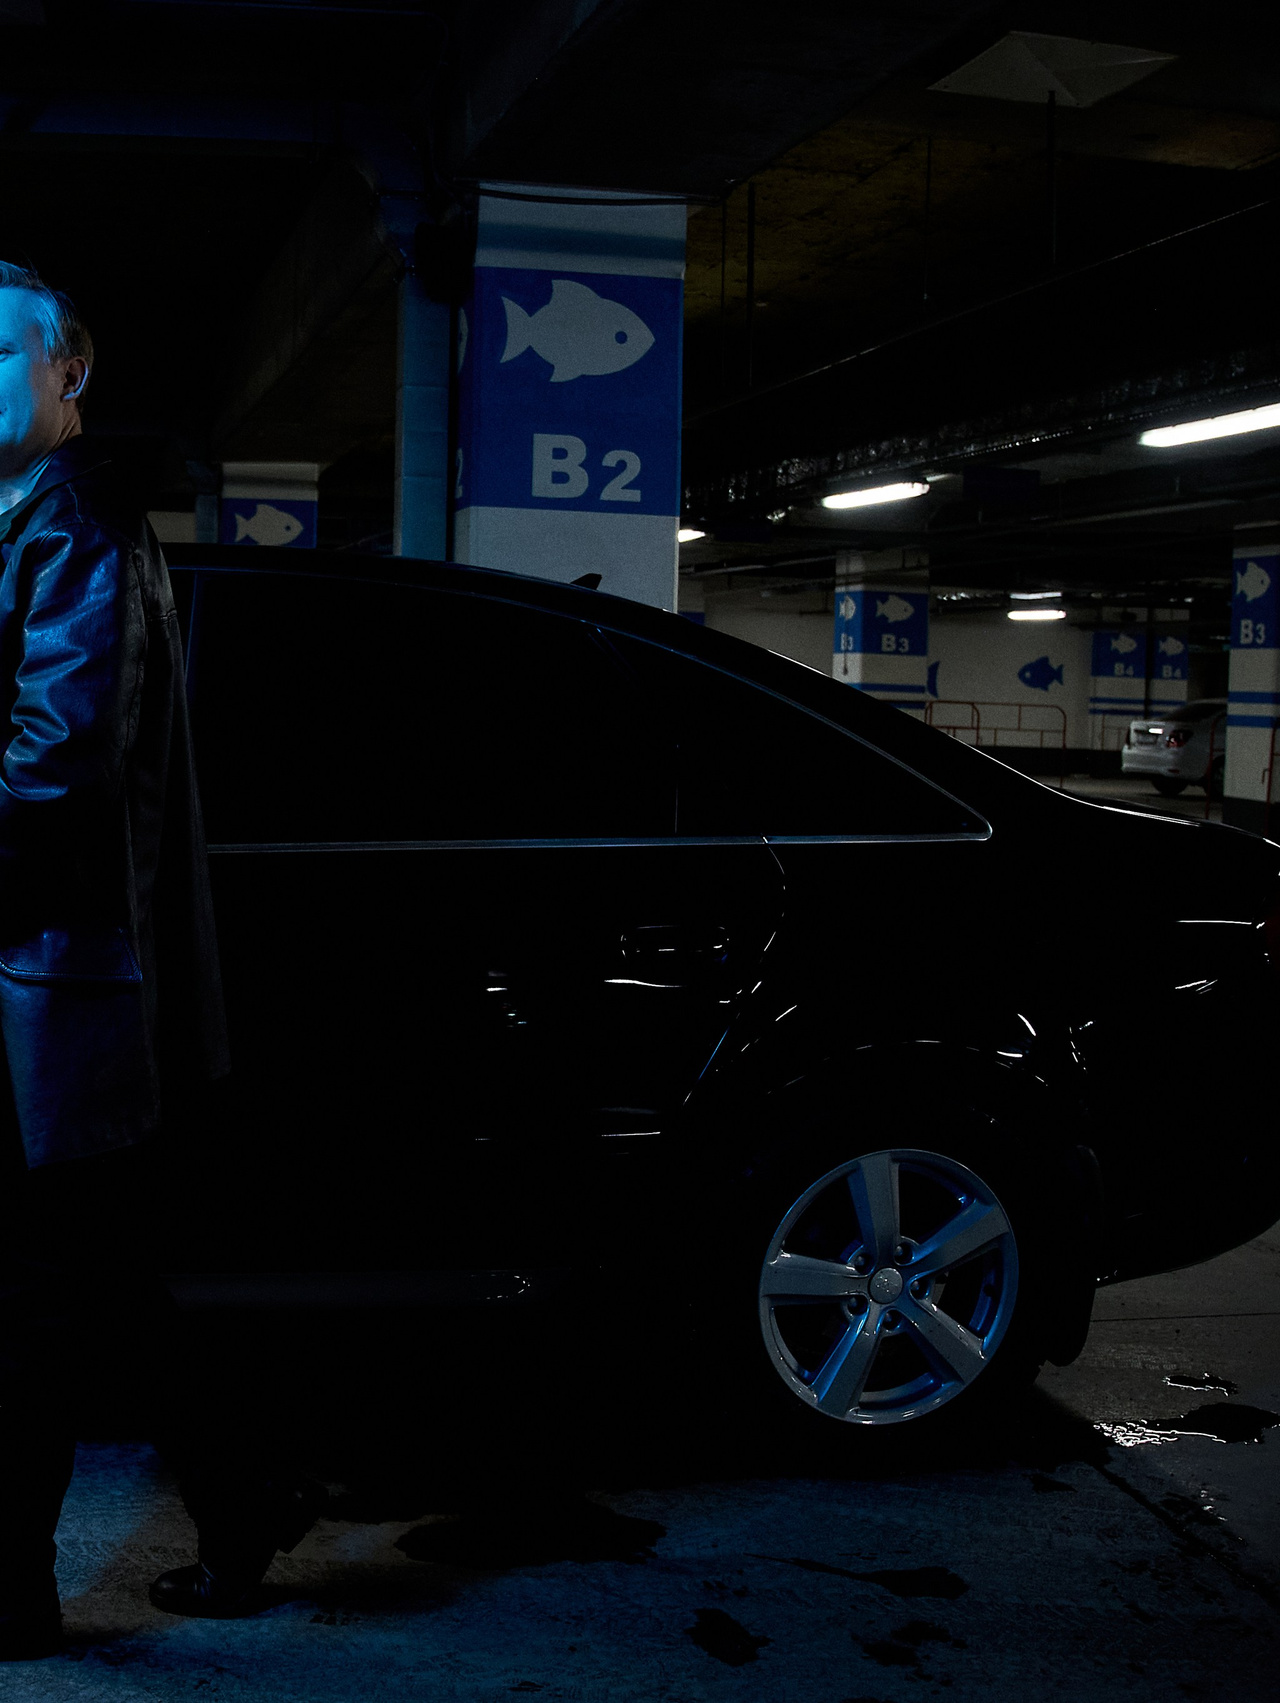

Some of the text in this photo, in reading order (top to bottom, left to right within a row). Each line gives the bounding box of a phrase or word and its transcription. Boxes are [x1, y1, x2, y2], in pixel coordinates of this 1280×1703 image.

[531, 433, 642, 503] B2
[1240, 618, 1266, 645] B3
[840, 632, 854, 651] B3
[880, 633, 910, 653] B3
[1114, 662, 1134, 676] B4
[1161, 664, 1182, 679] B4
